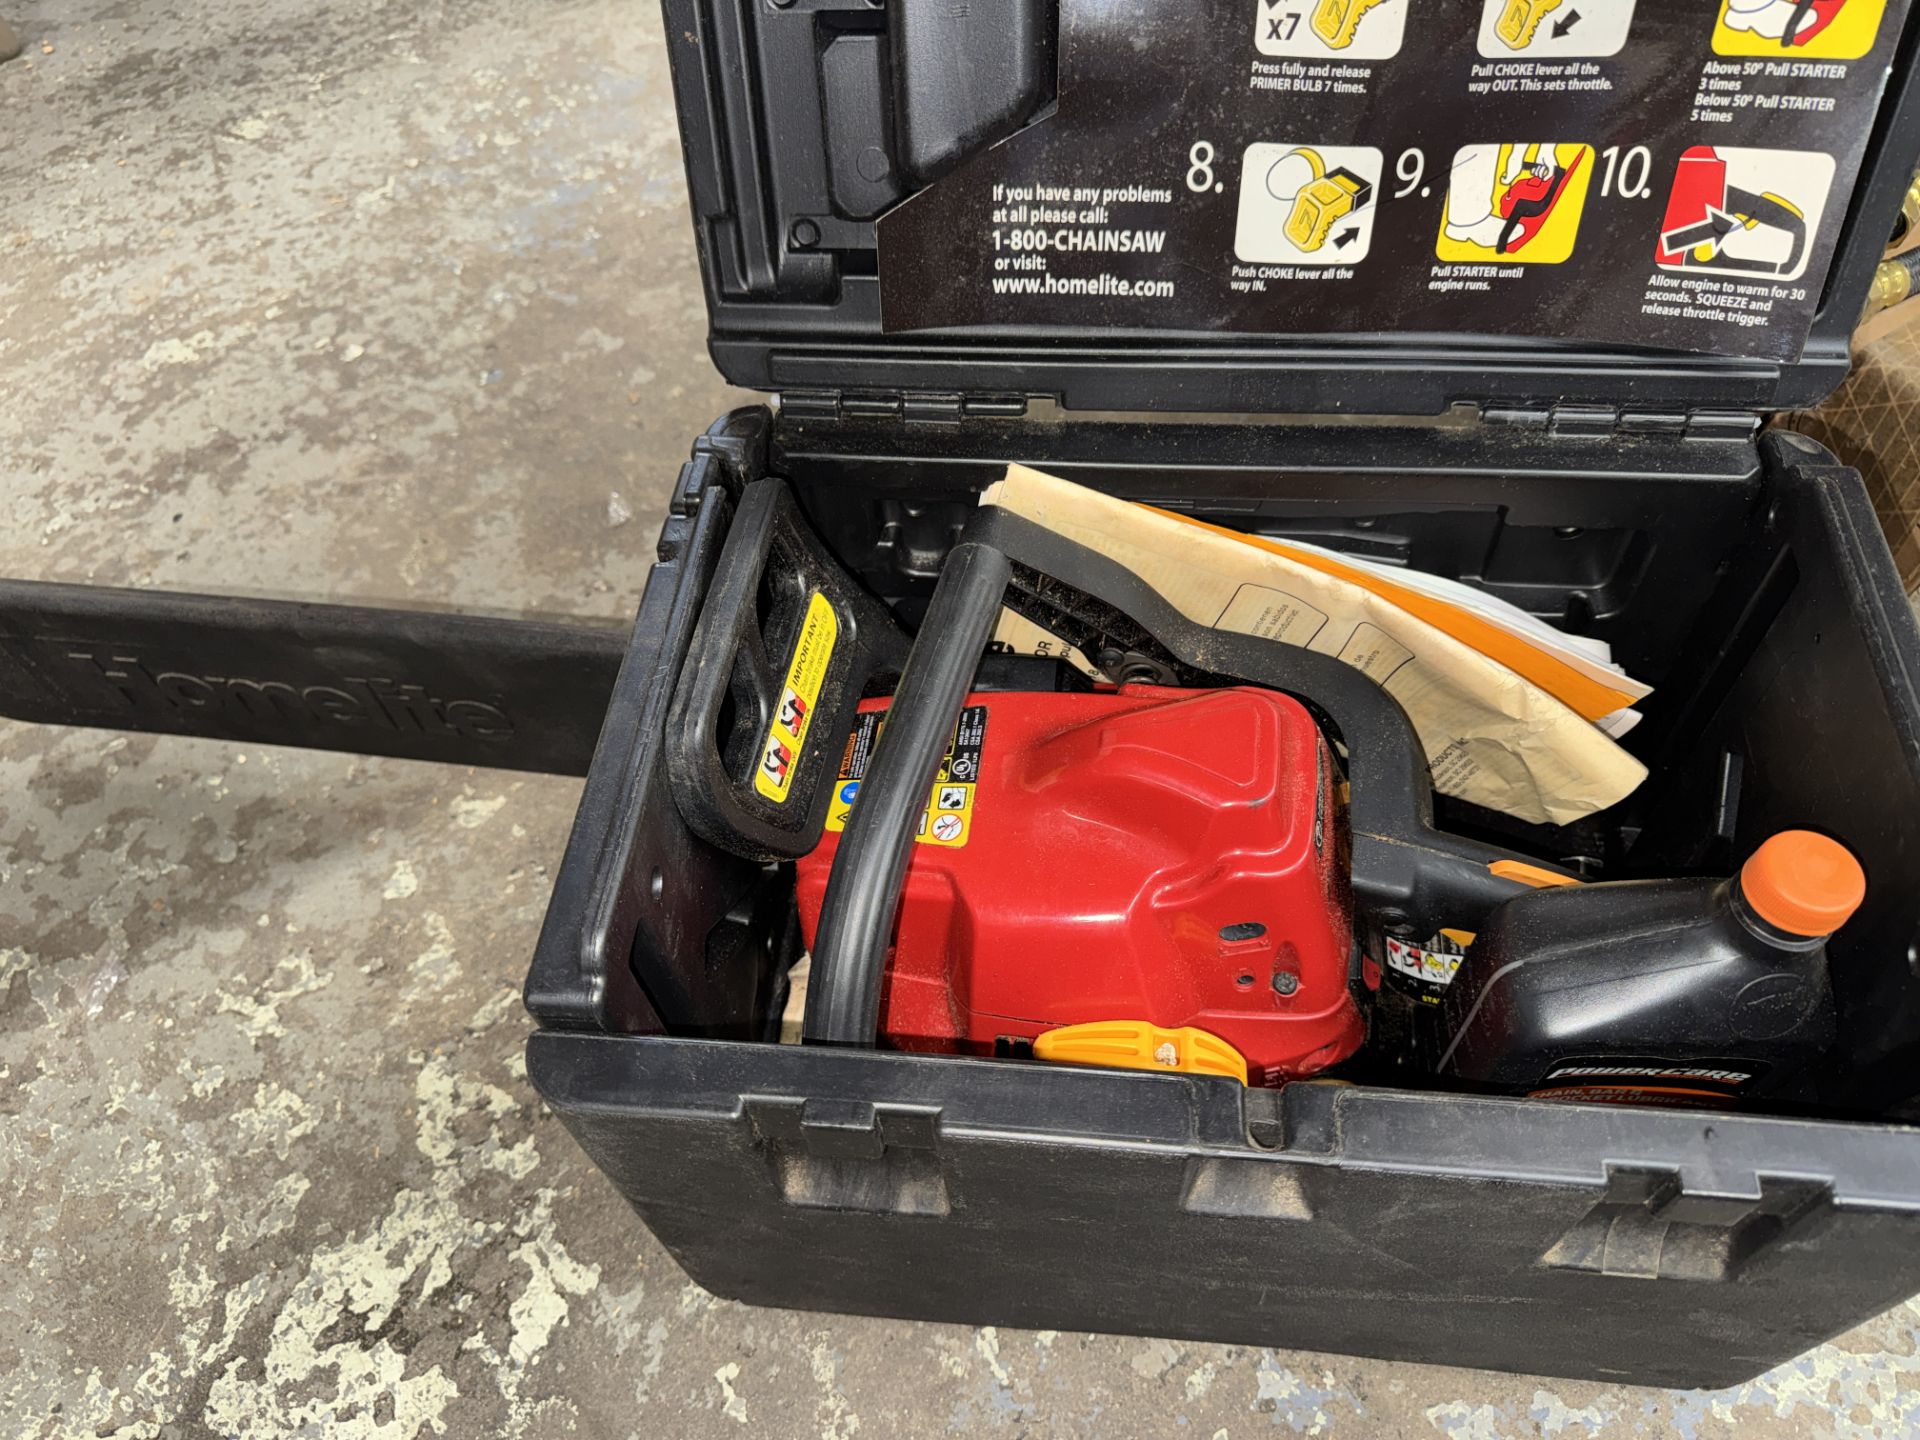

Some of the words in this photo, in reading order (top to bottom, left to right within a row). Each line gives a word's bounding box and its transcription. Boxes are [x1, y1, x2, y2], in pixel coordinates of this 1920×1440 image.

[1266, 13, 1301, 40] x7
[1252, 61, 1279, 74] Press
[1282, 63, 1306, 78] fully
[1308, 65, 1330, 77] and
[1331, 65, 1371, 78] release
[1471, 64, 1494, 76] Pull
[1495, 64, 1534, 76] CHOKE
[1535, 63, 1563, 76] lever
[1565, 63, 1580, 75] all
[1581, 63, 1600, 75] the
[1703, 61, 1741, 75] Above
[1765, 63, 1790, 76] Pull
[1790, 64, 1847, 79] STARTER
[1250, 77, 1290, 90] PRIMER
[1293, 79, 1322, 92] BULB
[1325, 81, 1331, 92] 7
[1333, 81, 1367, 93] times.
[1468, 82, 1490, 94] way
[1492, 79, 1518, 91] OUT.
[1520, 79, 1542, 91] This
[1543, 80, 1565, 91] sets
[1568, 78, 1613, 90] throttle.
[1699, 78, 1707, 90] 3
[1708, 78, 1742, 91] times
[1694, 93, 1731, 106] Below
[1755, 95, 1780, 108] Pull
[1780, 96, 1836, 112] STARTER
[1690, 109, 1699, 121] 5
[1700, 109, 1733, 122] times
[1186, 140, 1224, 194] 8.
[1393, 147, 1431, 199] 9.
[1600, 145, 1651, 200] 10.
[993, 185, 1004, 201] If
[1006, 188, 1033, 205] you
[1036, 183, 1070, 202] have
[1073, 188, 1100, 206] any
[1103, 185, 1172, 205] problems
[992, 209, 1007, 223] at
[1010, 206, 1027, 222] all
[1030, 206, 1076, 225] please
[1079, 207, 1109, 224] call:
[992, 230, 1166, 252] 1-800-CHAINSAW
[995, 257, 1010, 270] or
[1013, 254, 1047, 271] visit:
[1431, 266, 1451, 277] Pull
[1452, 266, 1498, 277] STARTER
[1499, 267, 1524, 278] until
[1232, 266, 1256, 278] Push
[1258, 267, 1294, 279] CHOKE
[1295, 268, 1321, 279] lever
[1322, 268, 1335, 279] all
[1336, 268, 1354, 279] the
[992, 273, 1175, 297] www.homelite.com
[1230, 281, 1251, 293] way
[1252, 280, 1266, 291] IN.
[1428, 279, 1464, 292] engine
[1465, 281, 1491, 290] runs.
[1648, 275, 1680, 288] Allow
[1682, 279, 1721, 292] engine
[1722, 282, 1735, 293] to
[1737, 284, 1770, 296] warm
[1770, 286, 1789, 298] for
[1789, 288, 1806, 301] 30
[1645, 290, 1692, 303] seconds.
[1695, 293, 1749, 309] SQUEEZE
[1749, 300, 1773, 311] and
[1641, 303, 1681, 316] release
[1682, 309, 1725, 321] throttle
[1727, 313, 1769, 326] trigger.
[792, 614, 819, 686] IMPORTANT
[67, 653, 515, 739] Homelite
